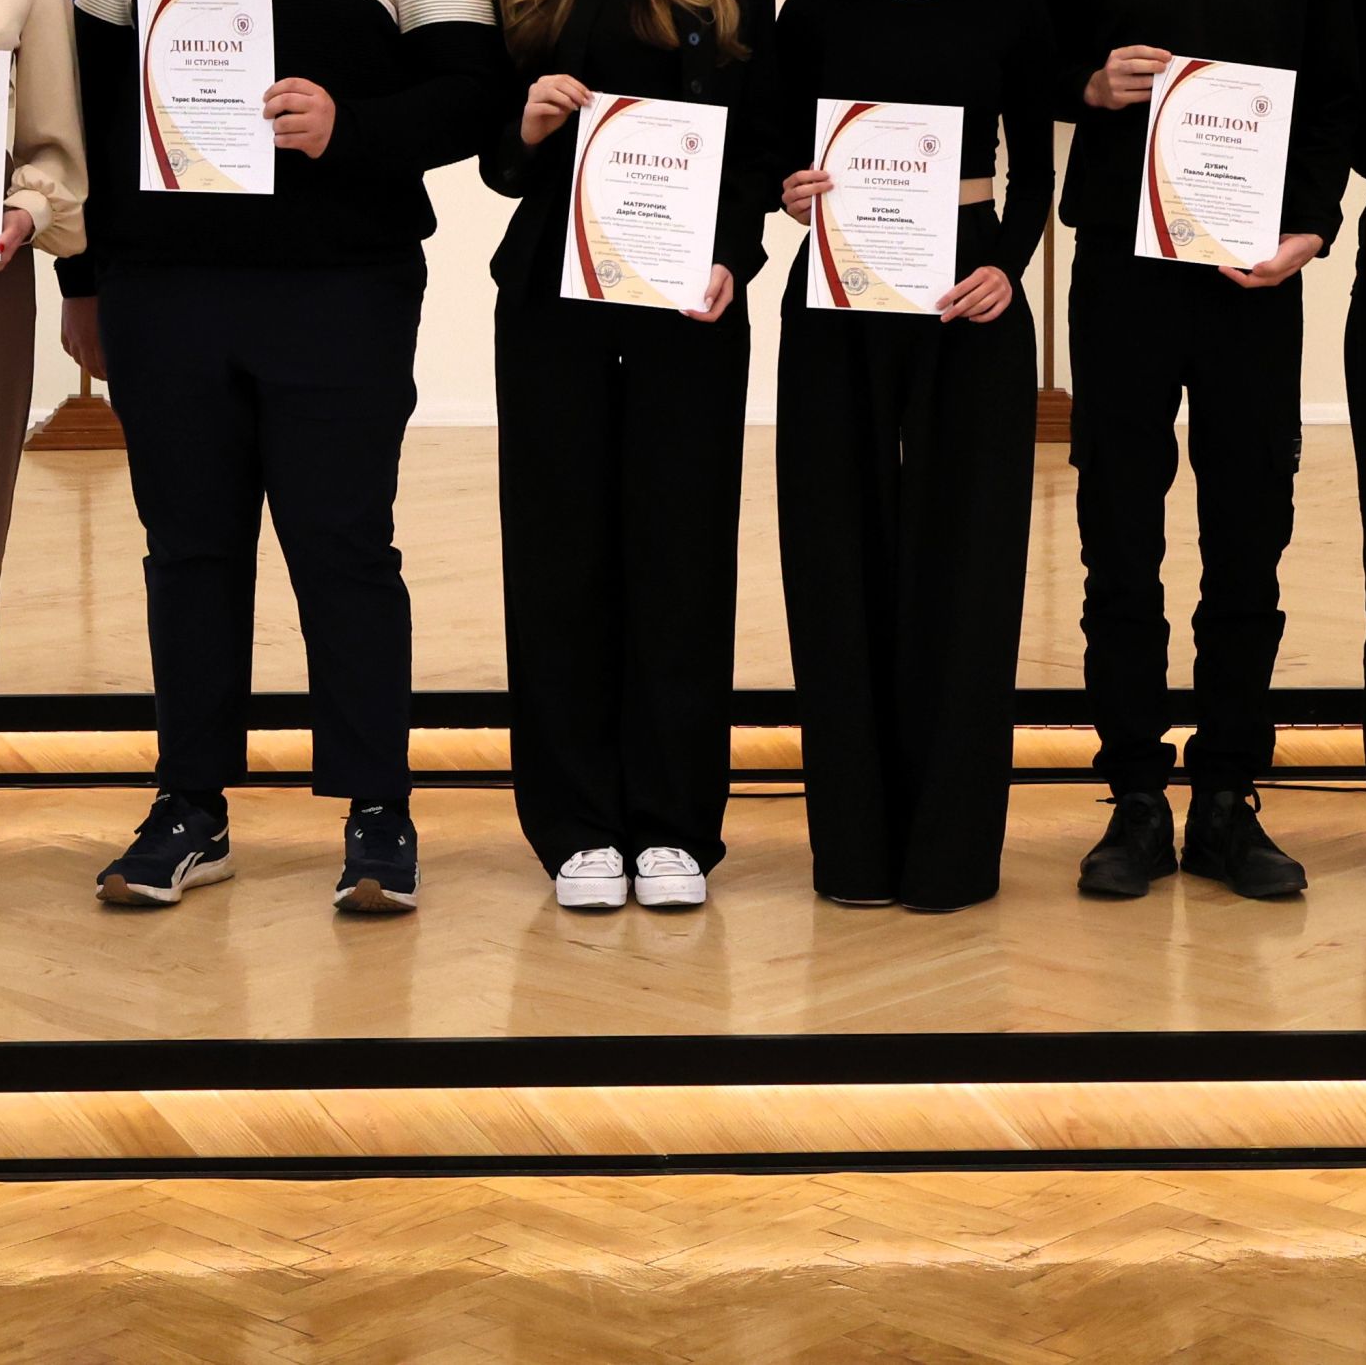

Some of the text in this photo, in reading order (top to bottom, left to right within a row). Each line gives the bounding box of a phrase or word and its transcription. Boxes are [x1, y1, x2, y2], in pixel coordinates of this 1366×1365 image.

[170, 40, 243, 53] ДИПЛОМ
[1182, 112, 1259, 133] ДИПЛОМ
[1205, 134, 1242, 144] СТУПЕНЯ
[609, 151, 689, 171] ДИПЛОМ
[848, 157, 927, 173] ДИПЛОМ
[631, 172, 669, 182] СТУПЕНЯ
[872, 178, 909, 186] СТУПЕНЯ
